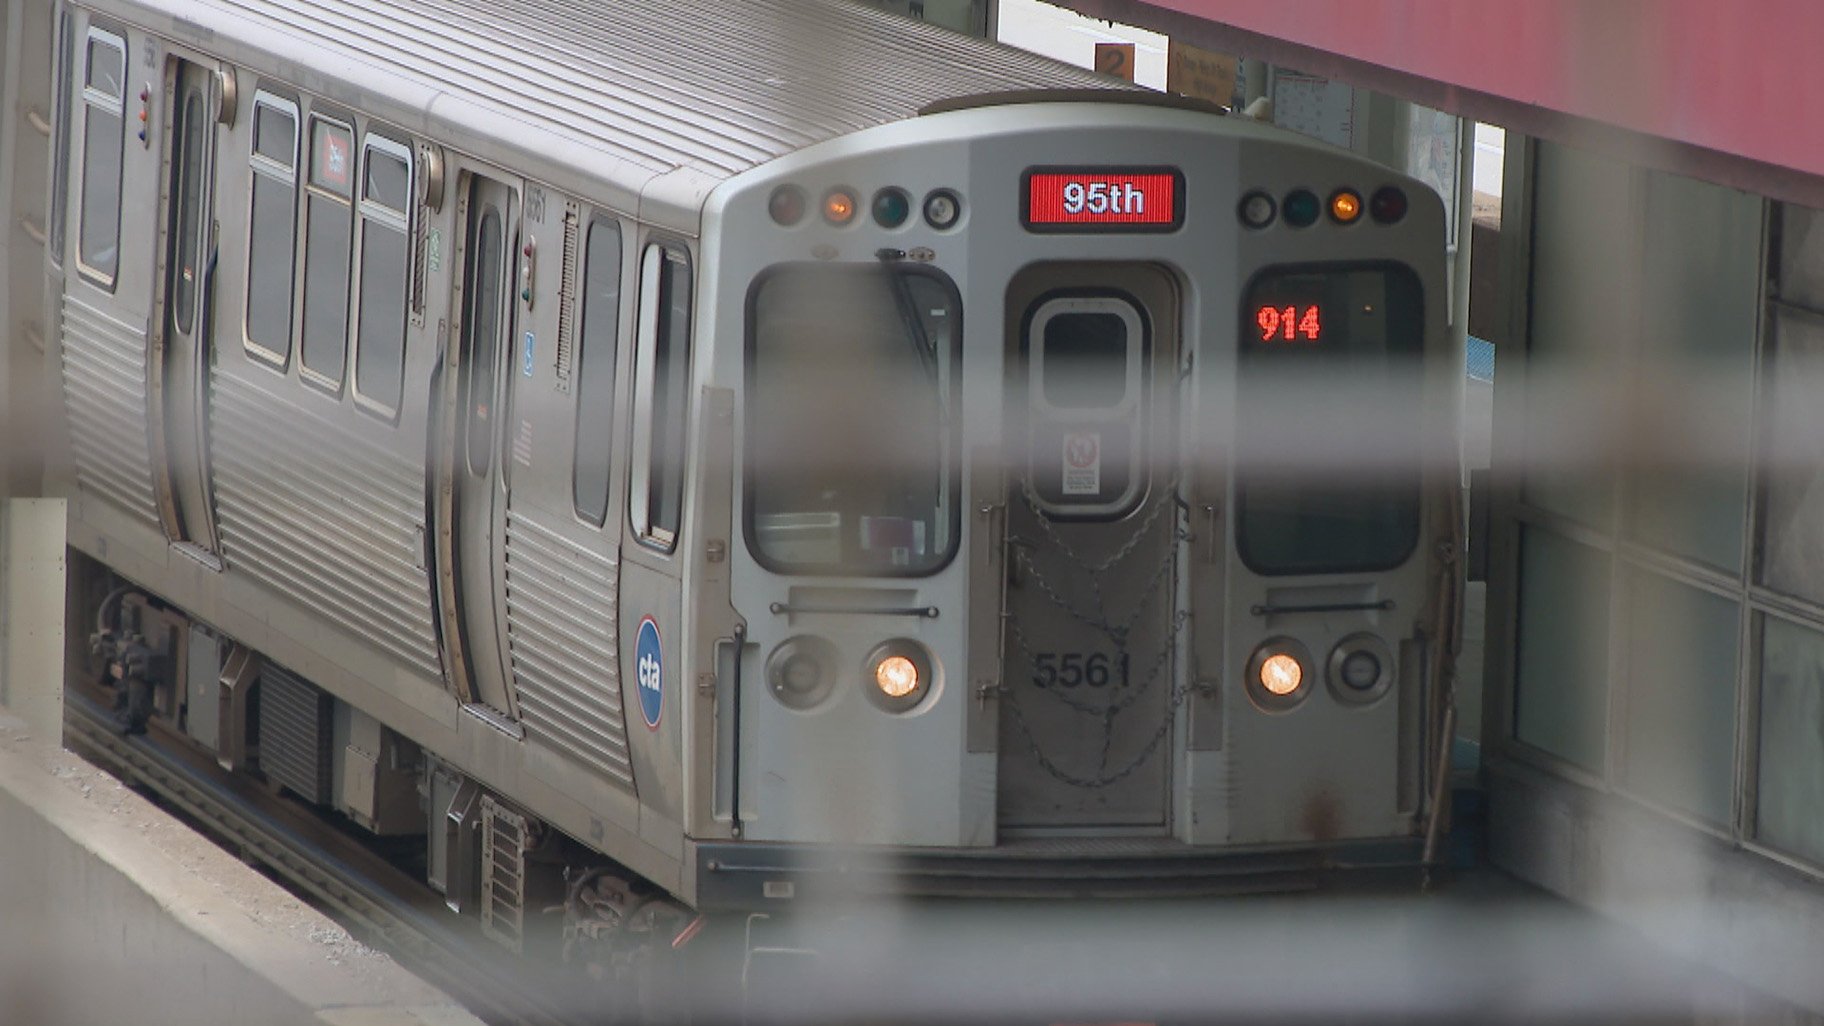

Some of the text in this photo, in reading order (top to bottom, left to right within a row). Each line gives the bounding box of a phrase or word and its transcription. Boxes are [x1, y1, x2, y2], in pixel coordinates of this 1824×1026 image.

[1104, 49, 1126, 78] 2
[1063, 182, 1144, 214] 95th
[1257, 305, 1320, 340] 914
[639, 653, 660, 692] cta
[1032, 652, 1130, 688] 5561
